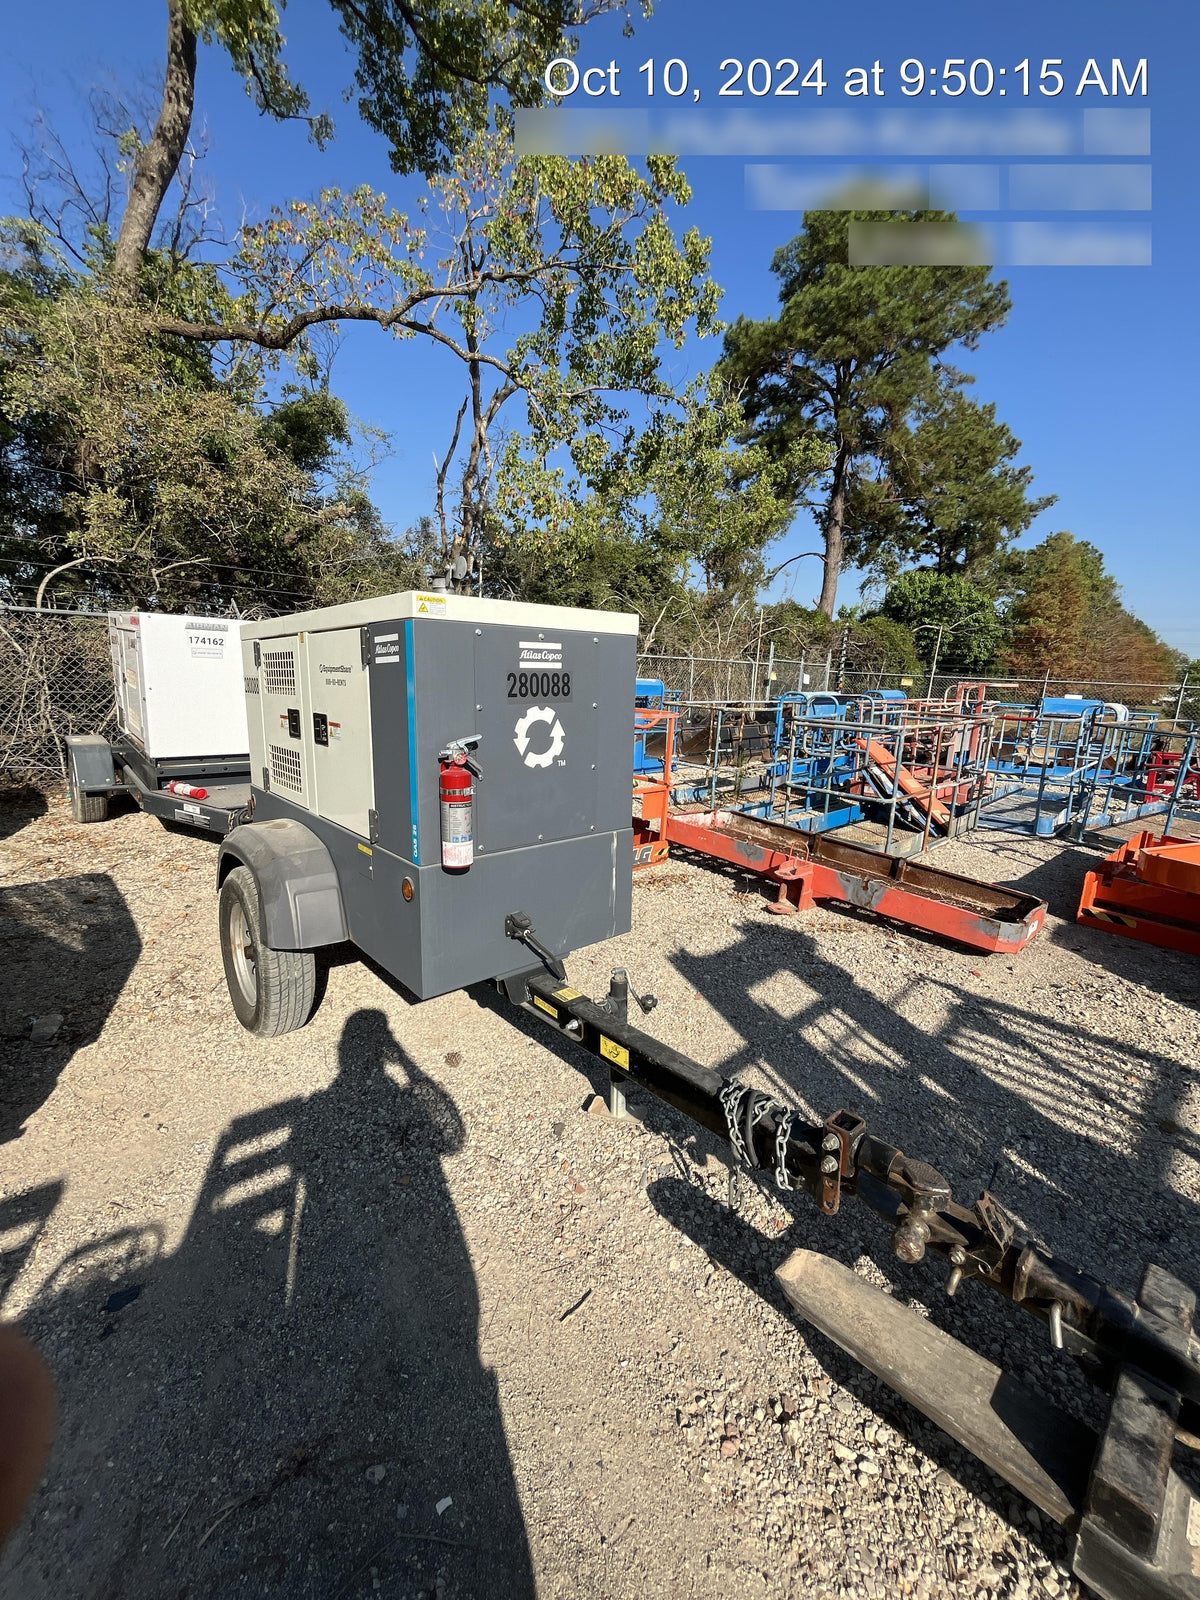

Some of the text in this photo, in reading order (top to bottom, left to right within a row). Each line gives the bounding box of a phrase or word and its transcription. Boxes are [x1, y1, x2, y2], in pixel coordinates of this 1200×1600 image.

[188, 636, 225, 647] 174162
[519, 650, 563, 662] Atlas Copco
[506, 672, 571, 698] 280088
[557, 759, 566, 767] TM
[633, 845, 653, 864] LG
